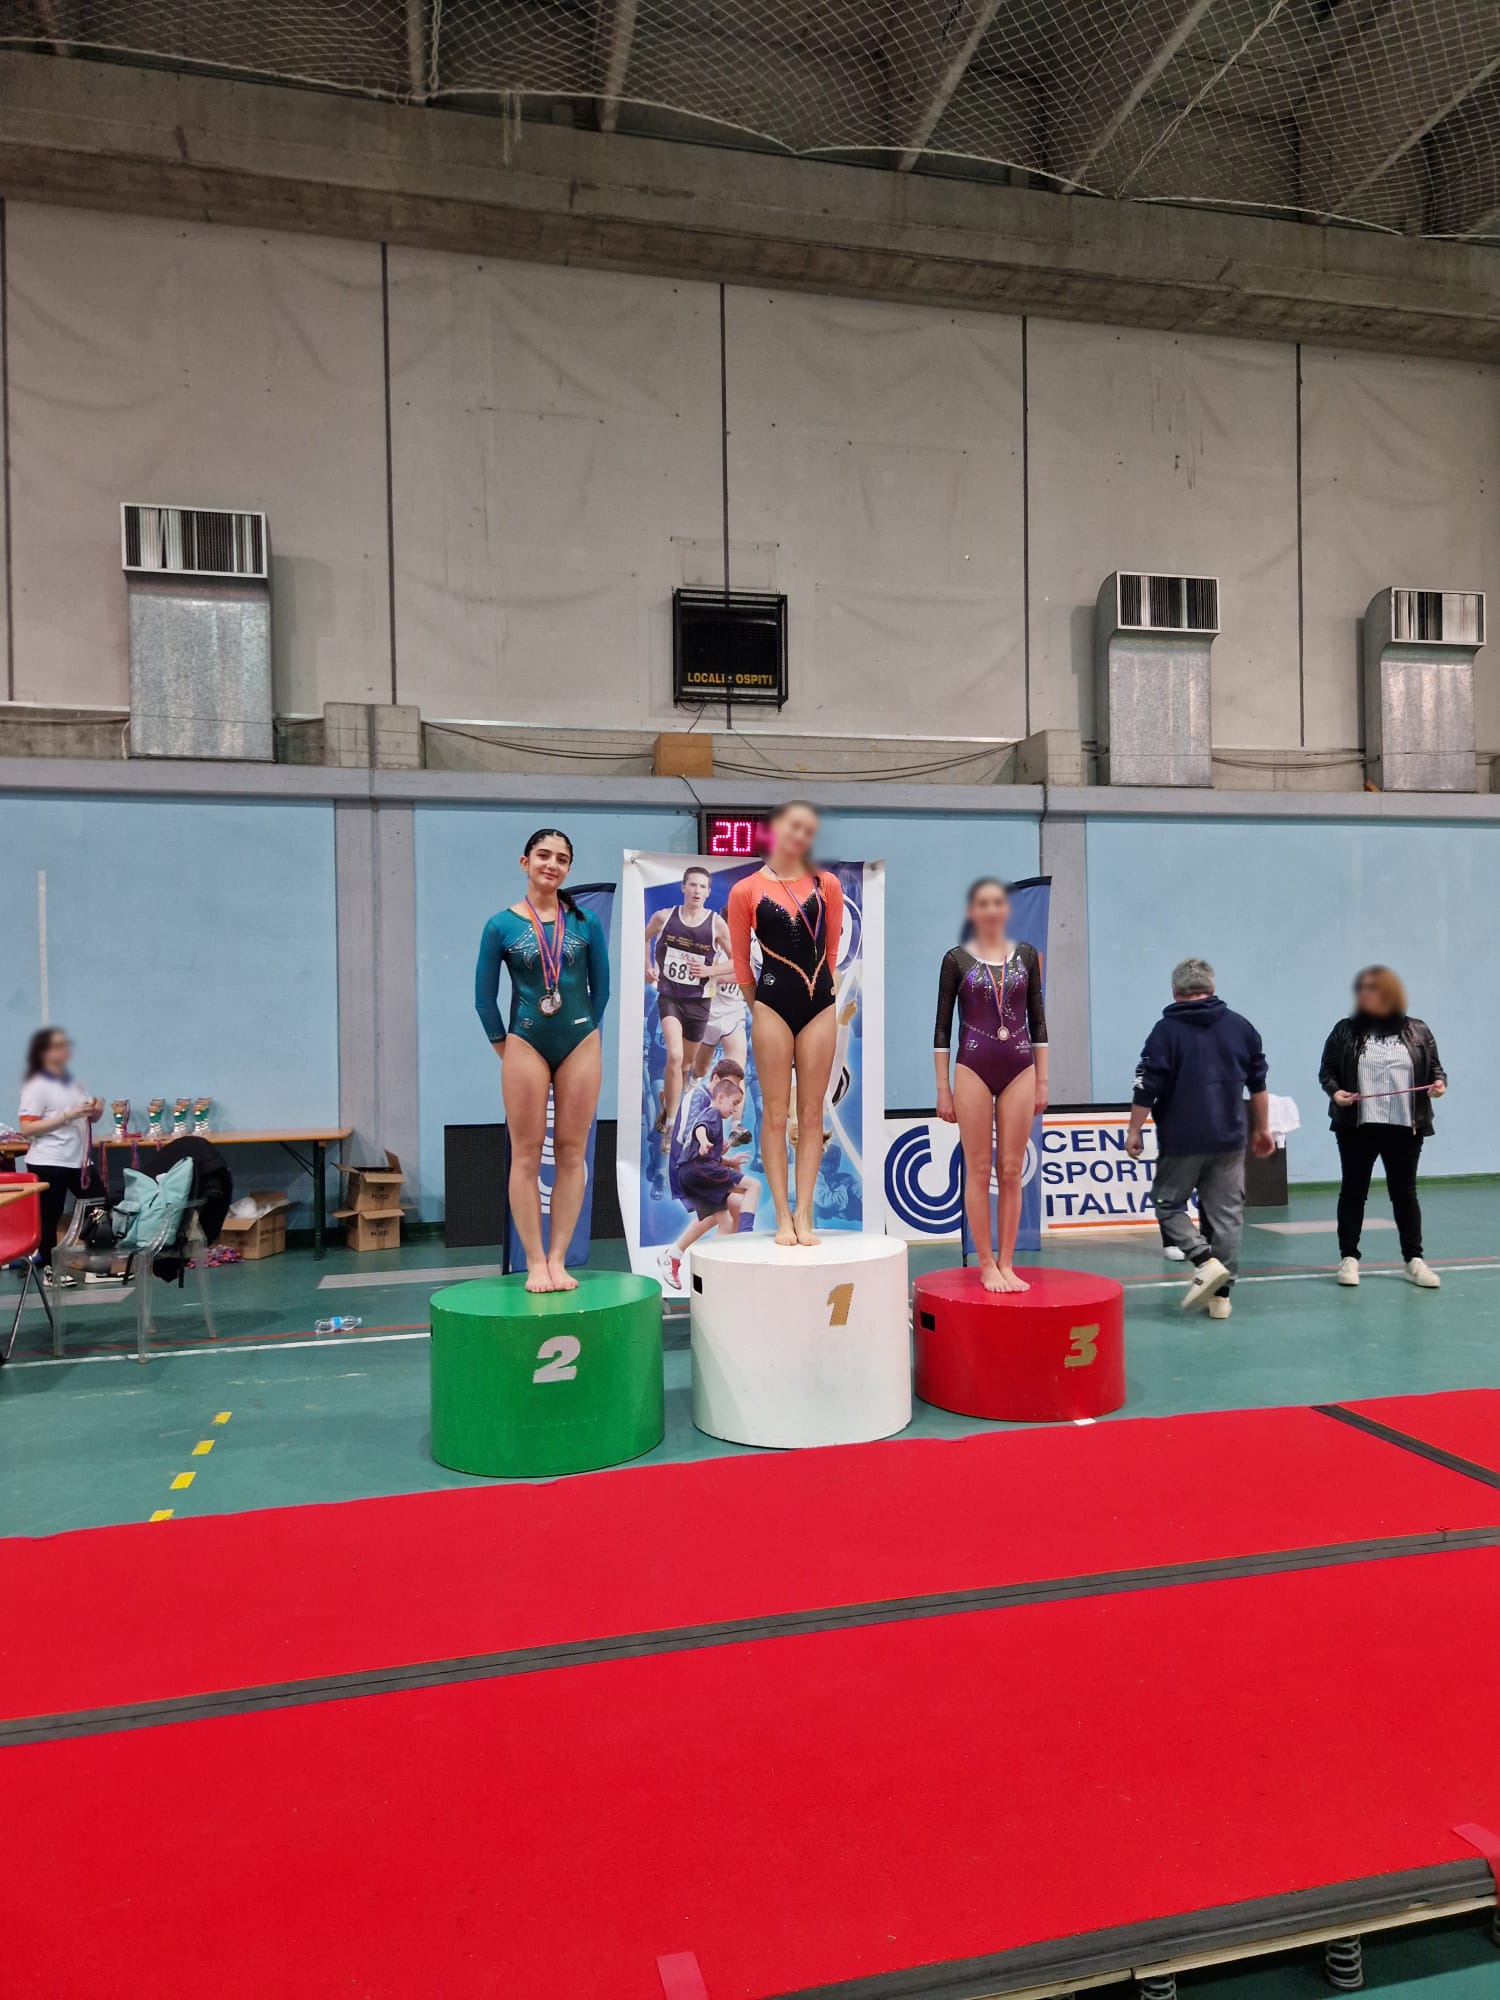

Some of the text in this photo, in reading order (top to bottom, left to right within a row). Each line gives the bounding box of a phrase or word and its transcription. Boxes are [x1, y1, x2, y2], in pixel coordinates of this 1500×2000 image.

[687, 672, 773, 685] LOCALI OSPITI
[712, 821, 752, 852] 20
[1041, 1128, 1152, 1153] CENT
[1041, 1159, 1157, 1184] SPORT
[1045, 1190, 1199, 1217] ITALIA
[827, 1283, 855, 1326] 1
[533, 1335, 581, 1384] 2
[1064, 1323, 1100, 1368] 3
